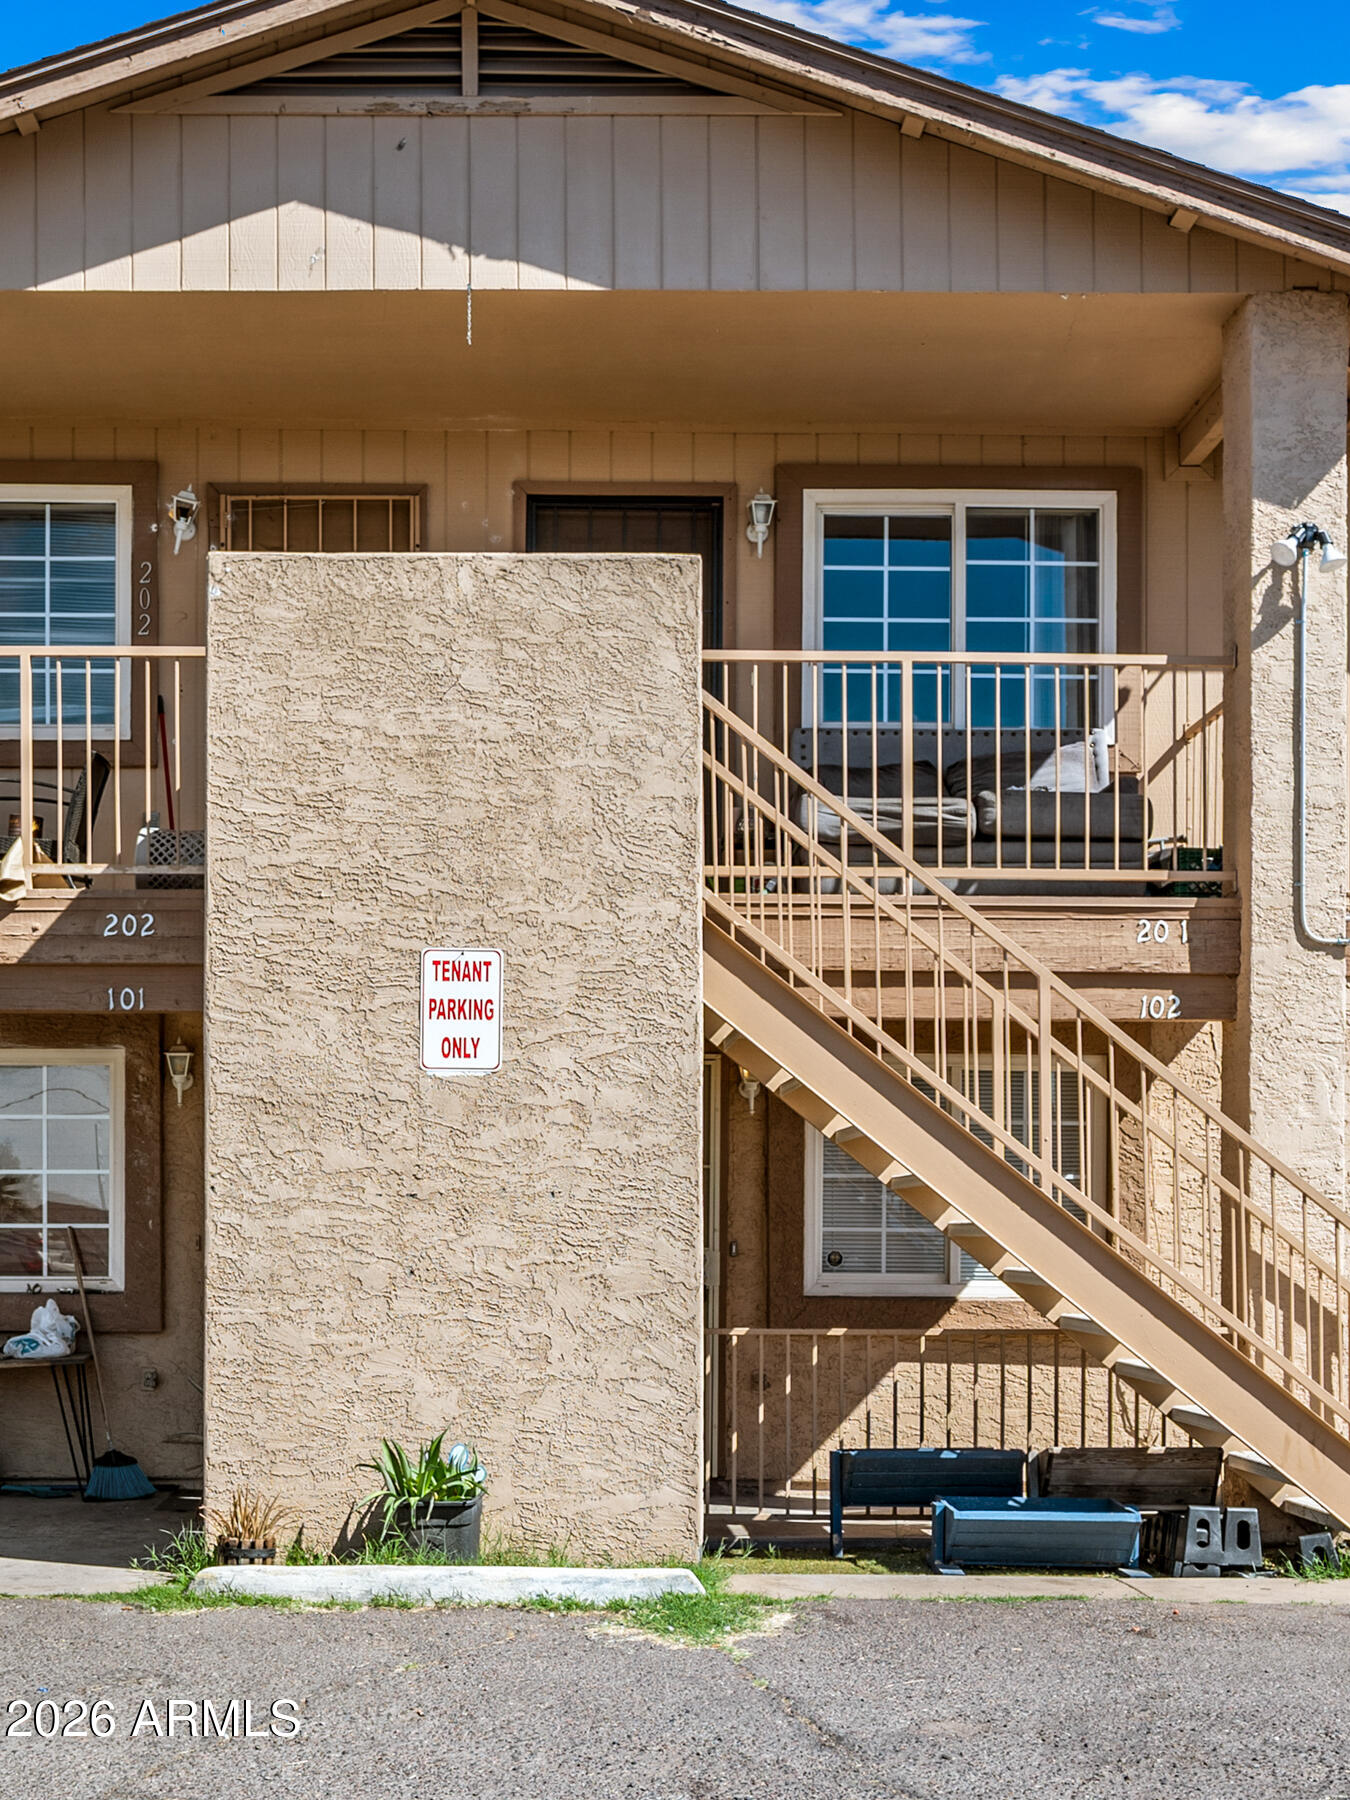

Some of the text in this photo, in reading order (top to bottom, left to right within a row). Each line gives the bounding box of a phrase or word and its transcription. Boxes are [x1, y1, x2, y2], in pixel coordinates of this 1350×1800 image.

[138, 561, 152, 636] 202
[103, 913, 155, 937] 202
[1137, 919, 1188, 944] 201
[432, 960, 492, 982] TENANT
[107, 987, 144, 1011] 101
[428, 998, 494, 1021] PARKING
[1140, 994, 1182, 1019] 102
[441, 1036, 480, 1059] ONLY
